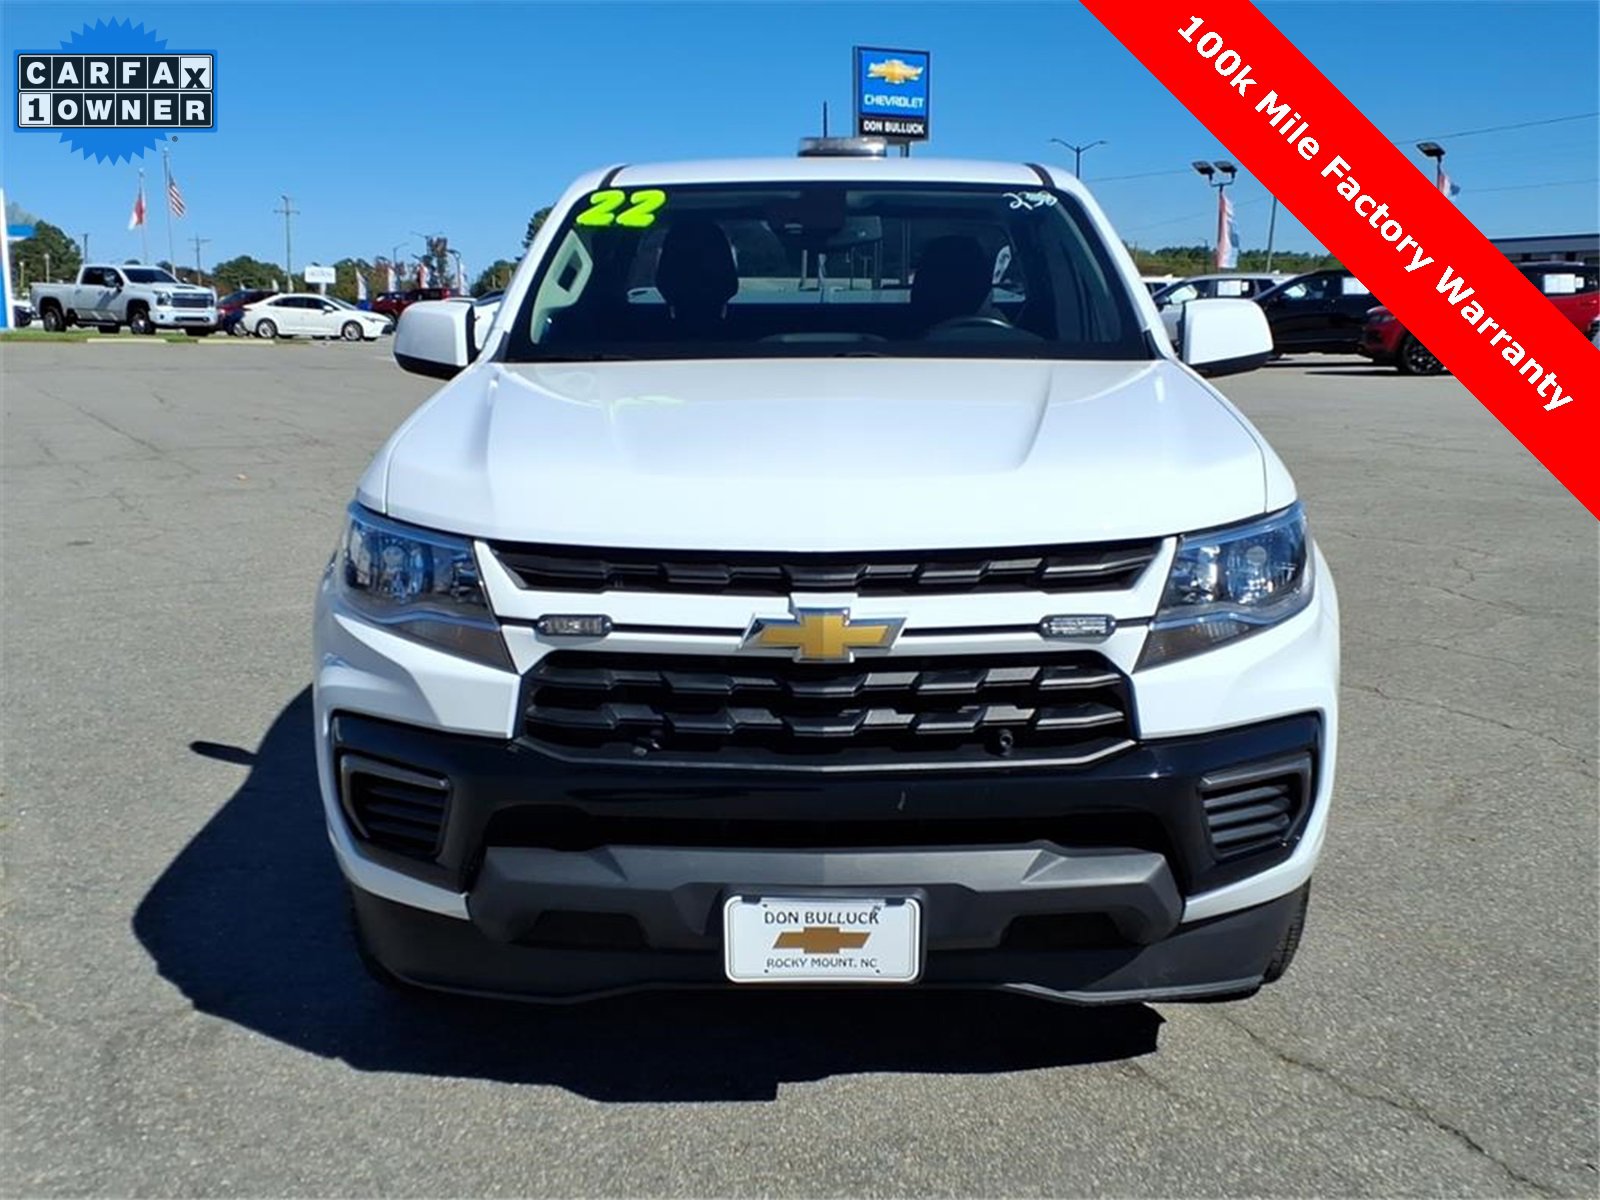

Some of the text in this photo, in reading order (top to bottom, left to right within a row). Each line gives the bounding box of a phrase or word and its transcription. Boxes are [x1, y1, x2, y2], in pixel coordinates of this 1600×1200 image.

[864, 94, 924, 108] CHEVROLET
[863, 121, 924, 134] DON BULLUCK
[576, 189, 666, 228] 22
[764, 911, 879, 925] DON BULLUCK
[766, 957, 808, 969] ROCKY
[861, 957, 878, 969] NC
